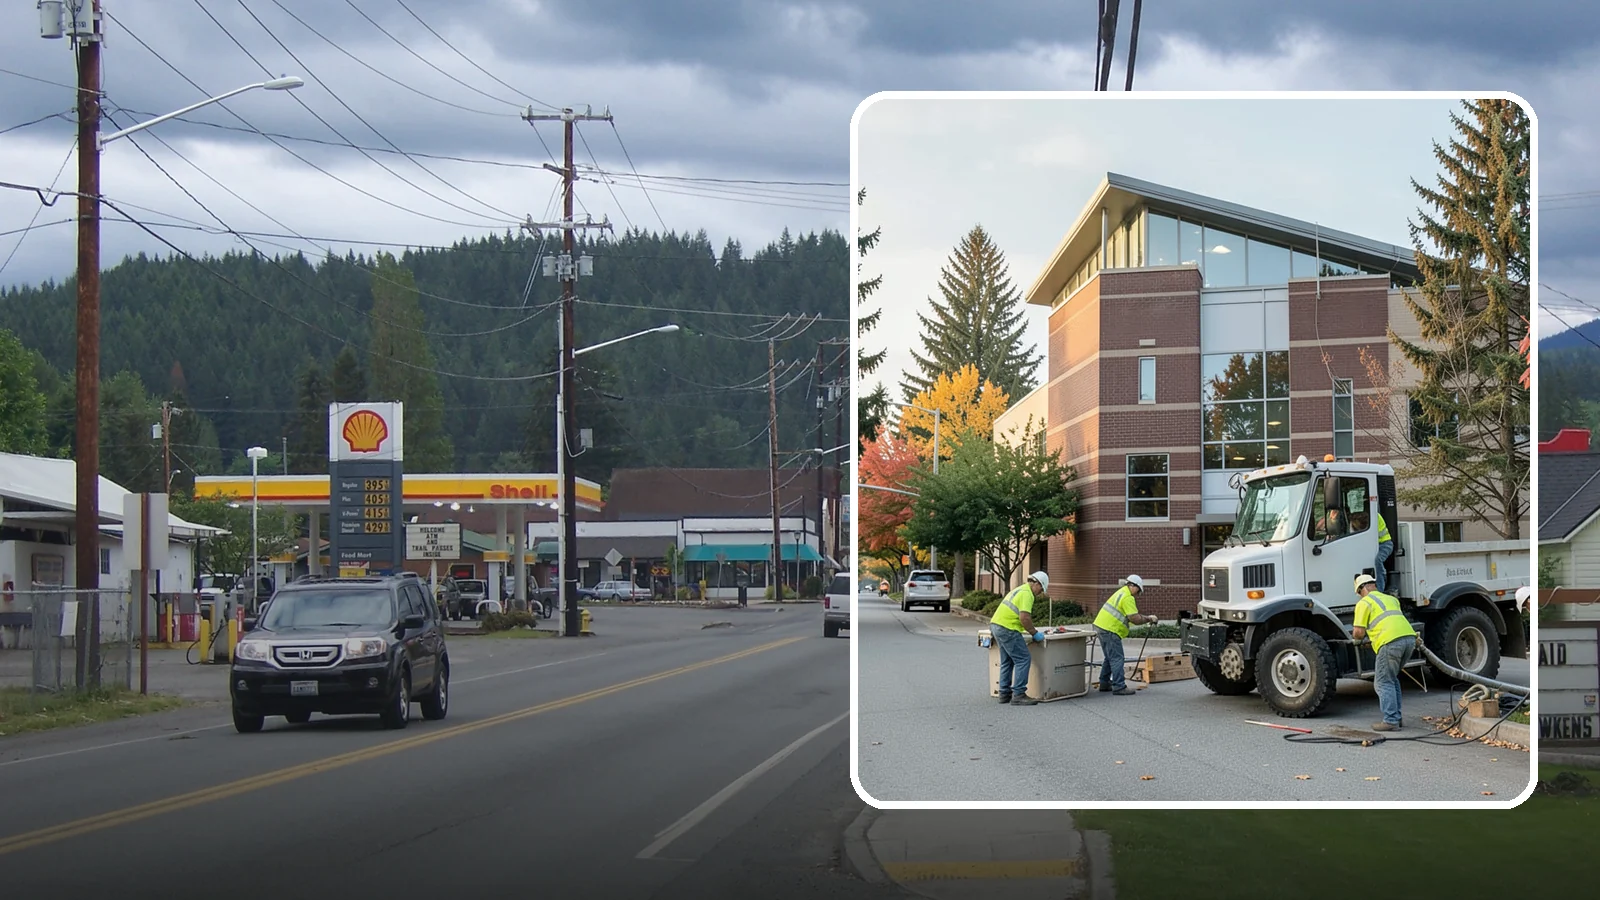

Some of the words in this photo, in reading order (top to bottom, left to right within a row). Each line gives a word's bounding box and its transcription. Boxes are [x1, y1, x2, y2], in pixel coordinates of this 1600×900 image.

[366, 480, 383, 490] 395
[490, 484, 547, 499] Shell
[366, 494, 383, 504] 405
[366, 508, 383, 518] 415
[366, 522, 383, 532] 429
[1538, 642, 1567, 665] AID
[1538, 715, 1592, 739] WKENS
